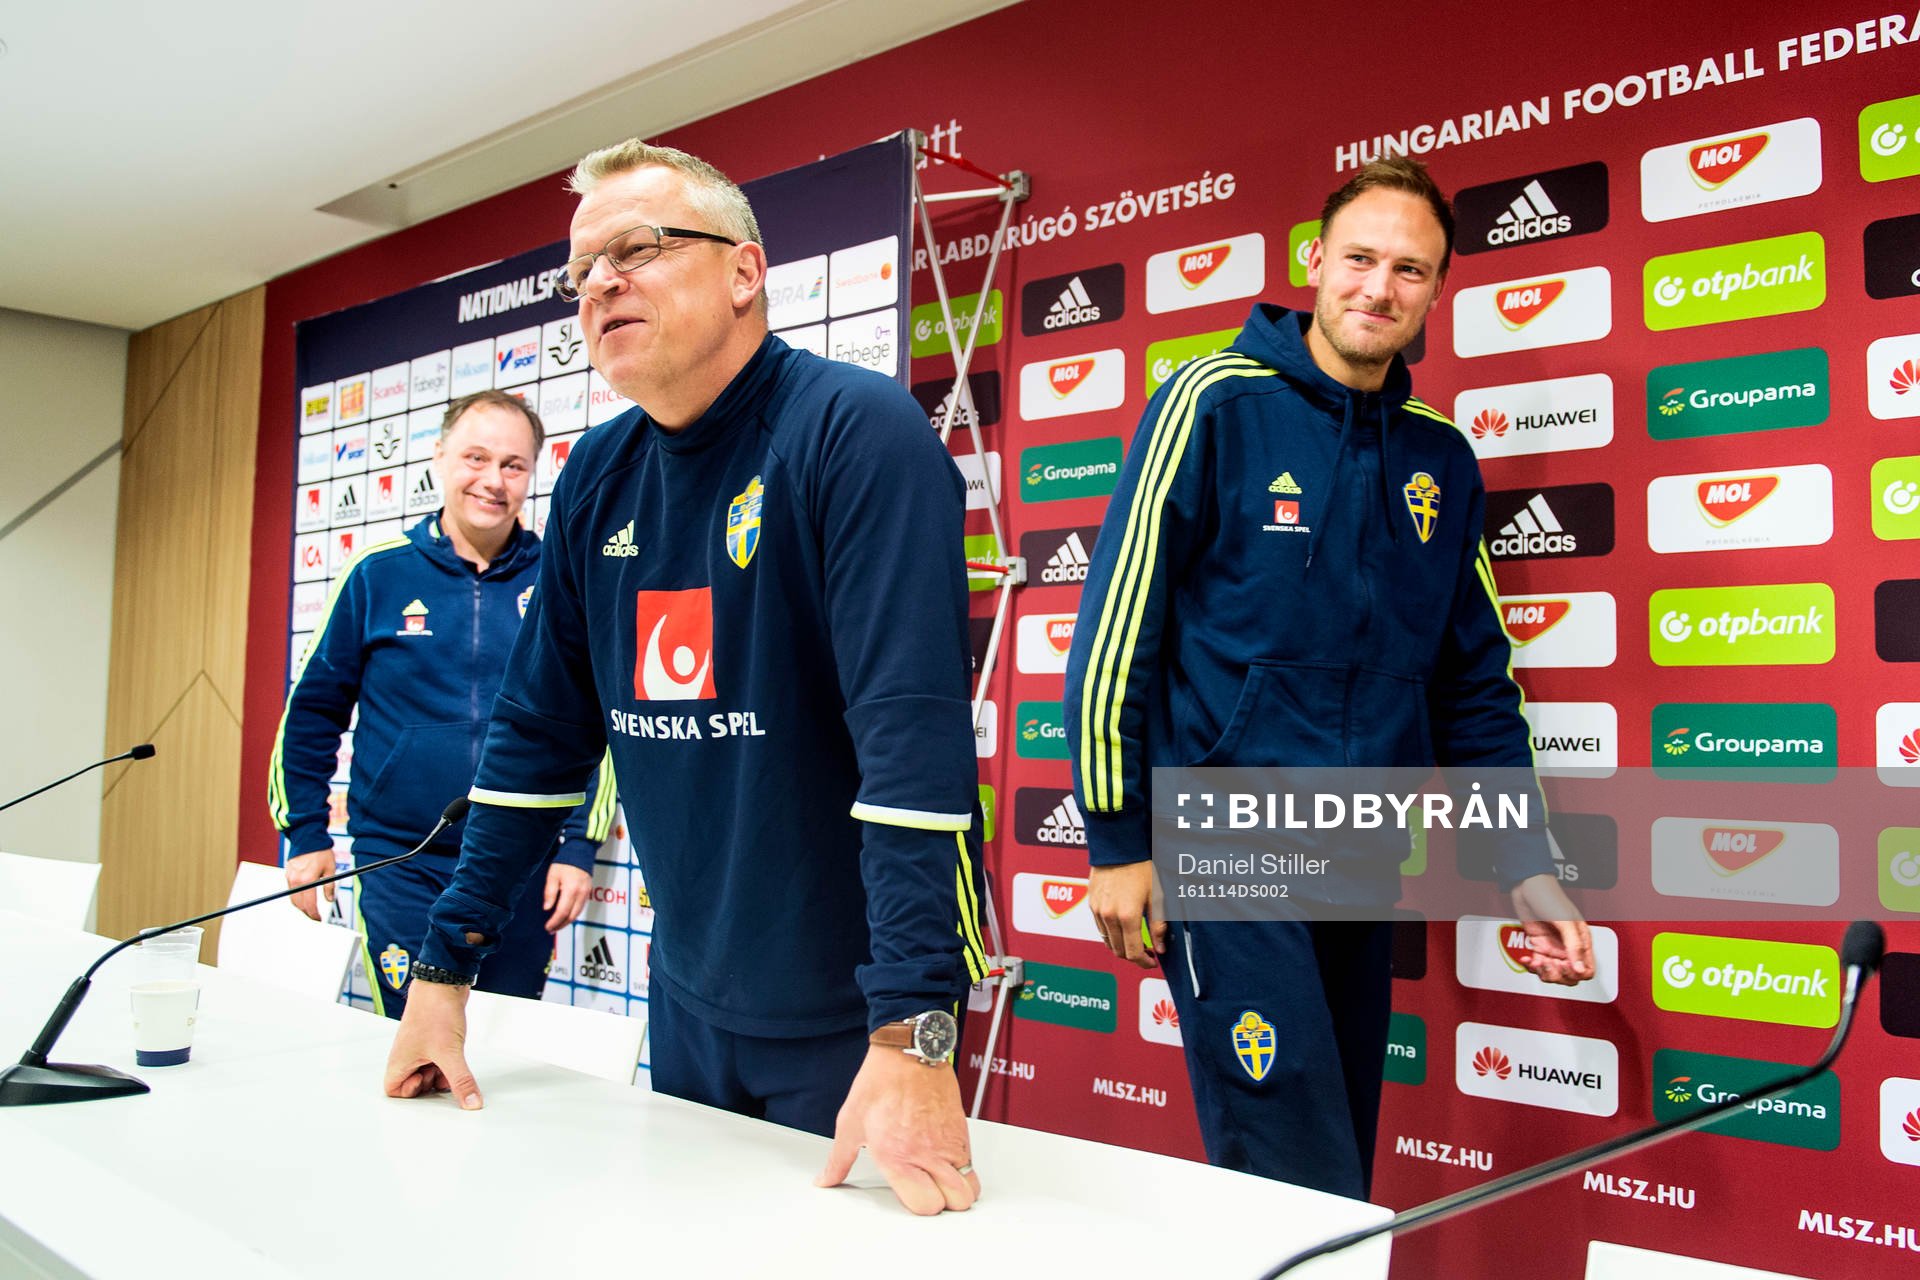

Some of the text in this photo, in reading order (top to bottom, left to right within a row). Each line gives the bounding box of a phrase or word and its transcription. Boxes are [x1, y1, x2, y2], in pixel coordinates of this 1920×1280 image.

[1335, 96, 1550, 172] HUNGARIAN
[1563, 48, 1765, 120] FOOTBALL
[1697, 143, 1742, 170] MOL
[1084, 170, 1236, 231] SZÖVETSÉG
[1487, 215, 1572, 246] adidas
[1183, 251, 1213, 272] MOL
[1691, 254, 1815, 301] otpbank
[1502, 287, 1543, 311] MOL
[1043, 306, 1101, 330] adidas
[1053, 364, 1080, 383] MOL
[591, 389, 624, 405] RIC
[1689, 382, 1816, 409] Groupama
[1515, 408, 1597, 431] HUAWEI
[1043, 462, 1117, 480] Groupama
[1705, 482, 1752, 505] MOL
[1490, 531, 1577, 556] adidas
[1041, 564, 1088, 583] adida
[1506, 606, 1546, 625] MOL
[1698, 605, 1824, 644] otpbank
[611, 708, 766, 740] SVENSKA SPEL
[1532, 737, 1601, 752] UAWEI
[1694, 732, 1824, 757] Groupama
[1037, 824, 1087, 846] adida
[1710, 832, 1757, 853] MOL
[590, 886, 626, 905] ICOH
[1046, 885, 1073, 901] MOL
[580, 963, 622, 984] adidas
[1702, 963, 1829, 998] otpbank
[1036, 985, 1111, 1011] Groupama
[969, 1053, 1035, 1081] MSZ.HU
[1518, 1063, 1602, 1090] HUAWEI
[1092, 1077, 1167, 1108] MLSZ.HU
[1395, 1135, 1493, 1172] MLSZ.HU
[1582, 1170, 1696, 1210] MLSZ.HU
[1798, 1208, 1920, 1253] MLSZ.HU
